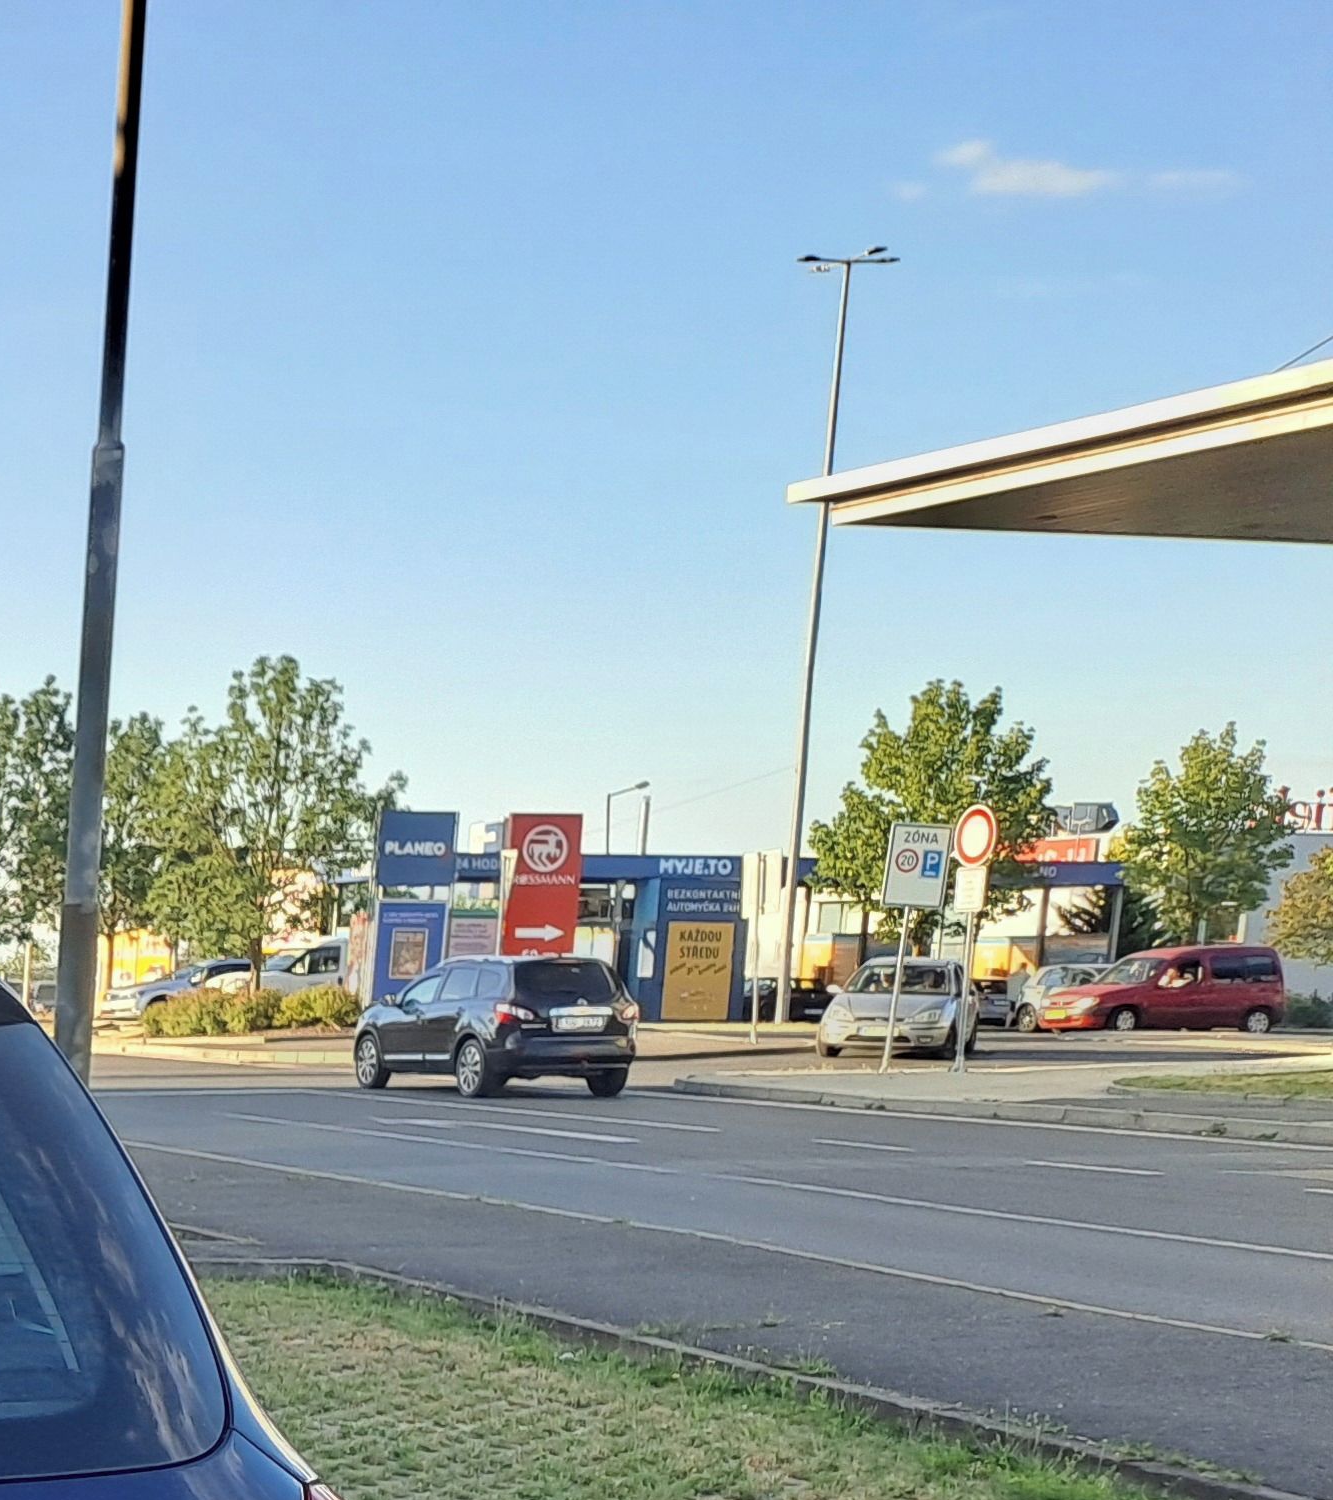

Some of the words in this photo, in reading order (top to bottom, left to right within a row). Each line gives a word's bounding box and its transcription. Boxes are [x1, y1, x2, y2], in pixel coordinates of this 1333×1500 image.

[903, 830, 939, 844] ZÓNA
[384, 841, 447, 857] PLANEO
[659, 858, 733, 876] MYJE.TO
[900, 854, 915, 867] 20
[666, 900, 721, 913] AUTOMYČKA
[679, 928, 722, 942] KAŽDOU
